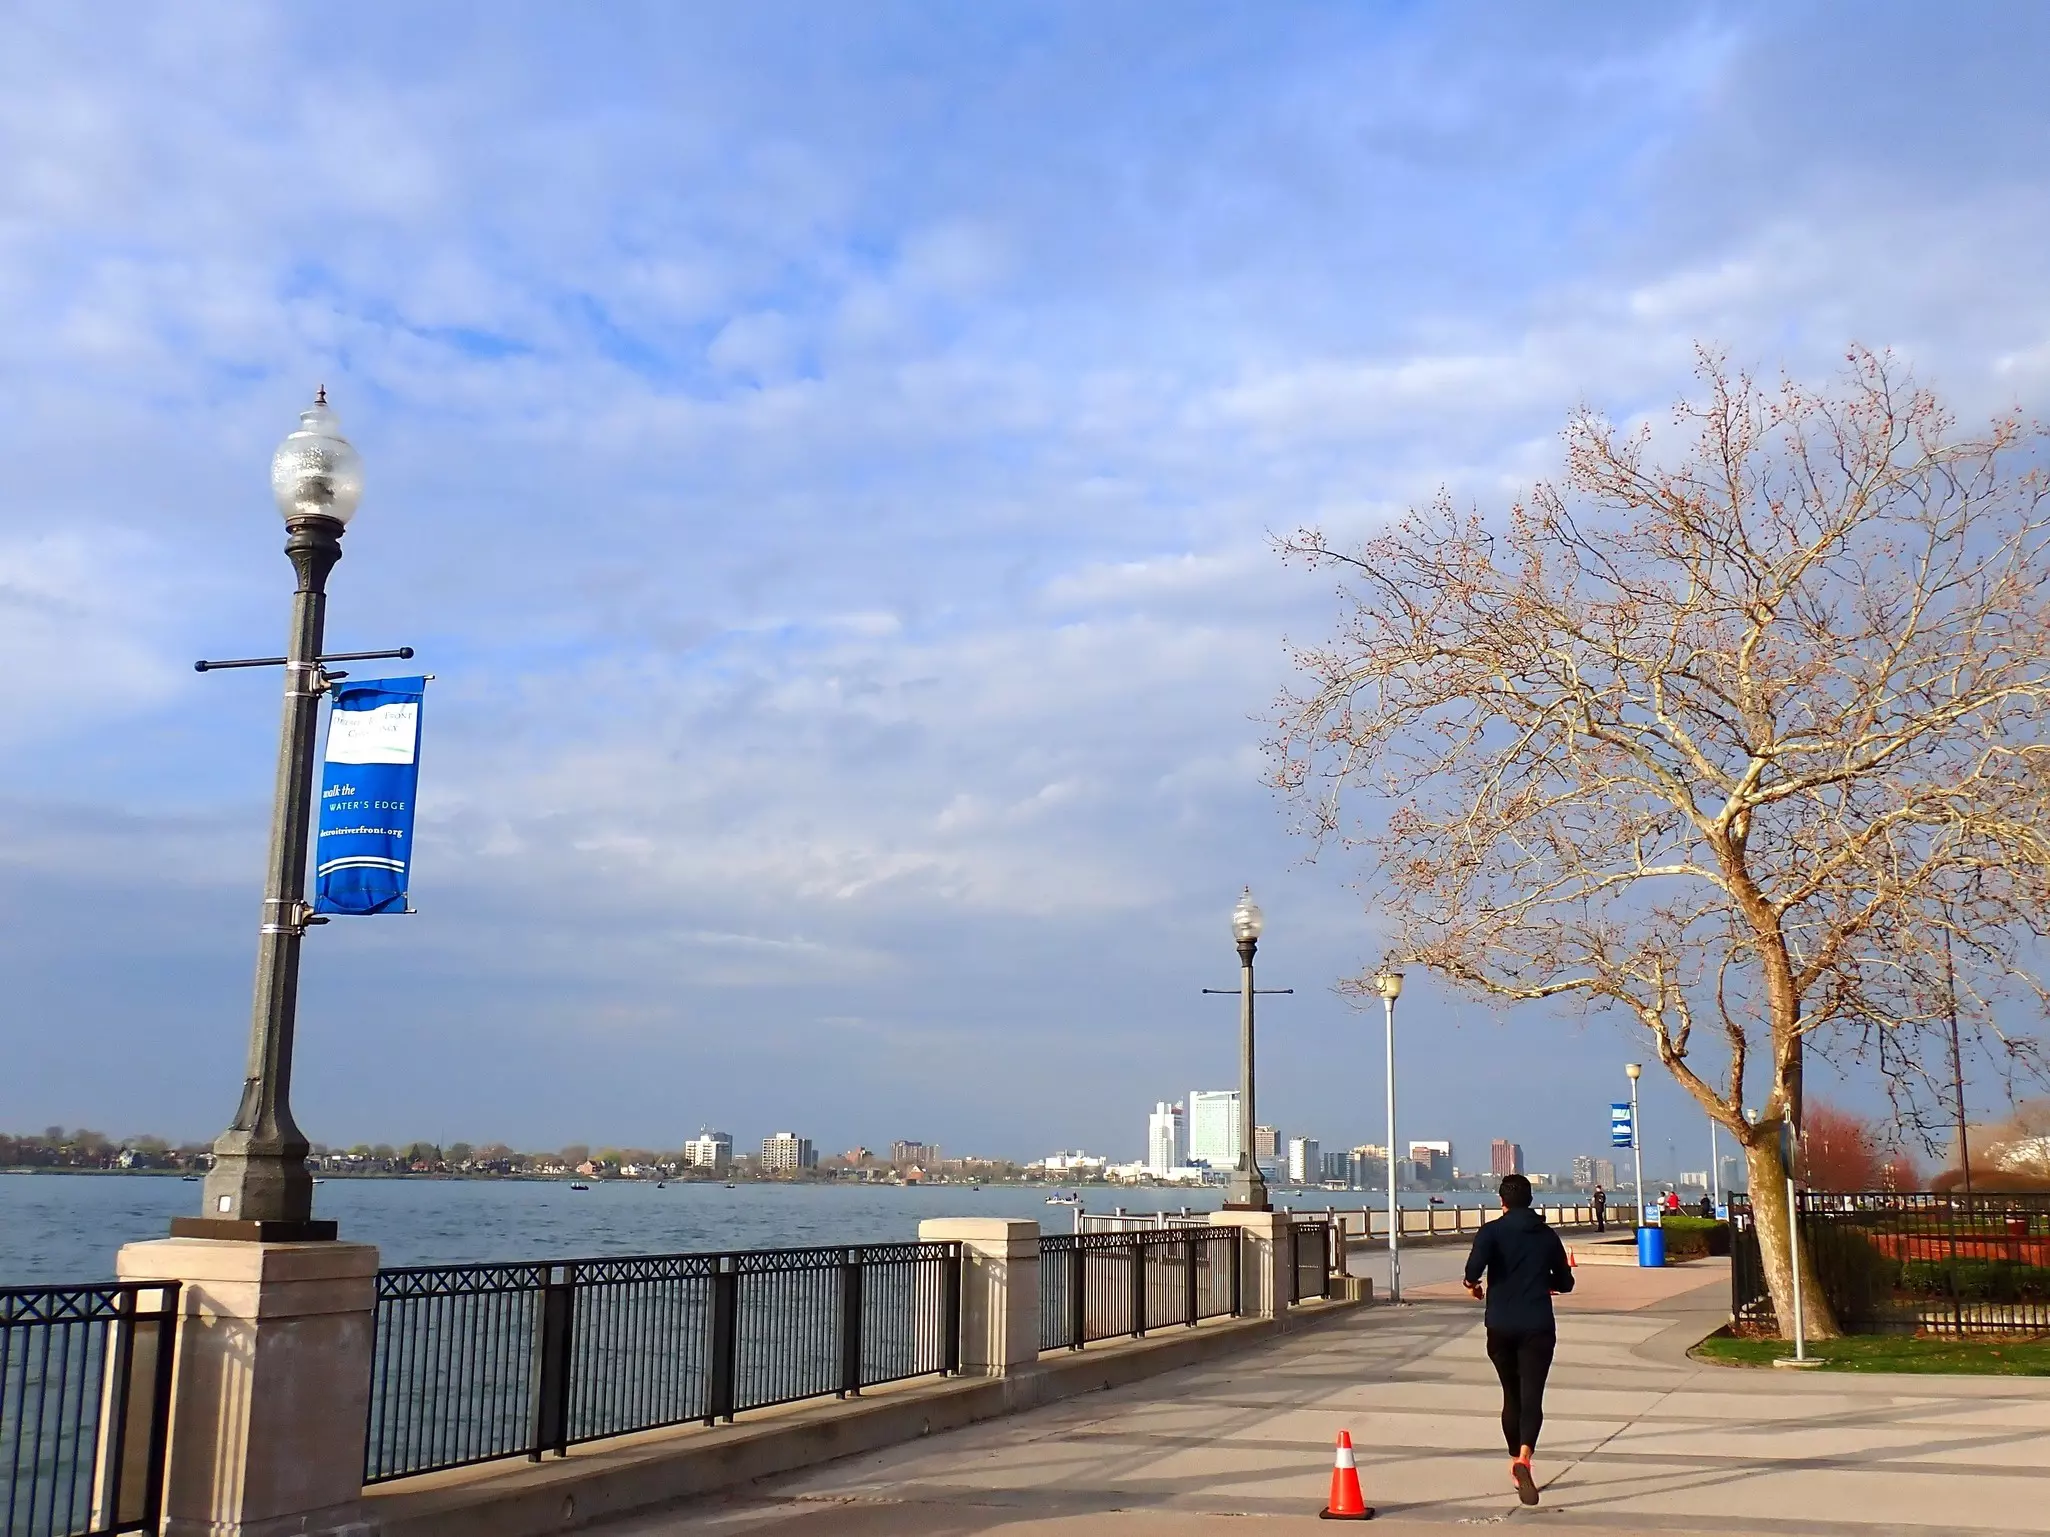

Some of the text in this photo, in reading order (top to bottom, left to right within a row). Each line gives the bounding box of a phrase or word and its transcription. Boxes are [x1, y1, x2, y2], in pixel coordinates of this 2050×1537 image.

[322, 783, 356, 799] walk the
[329, 800, 405, 812] WATER'S EDGE
